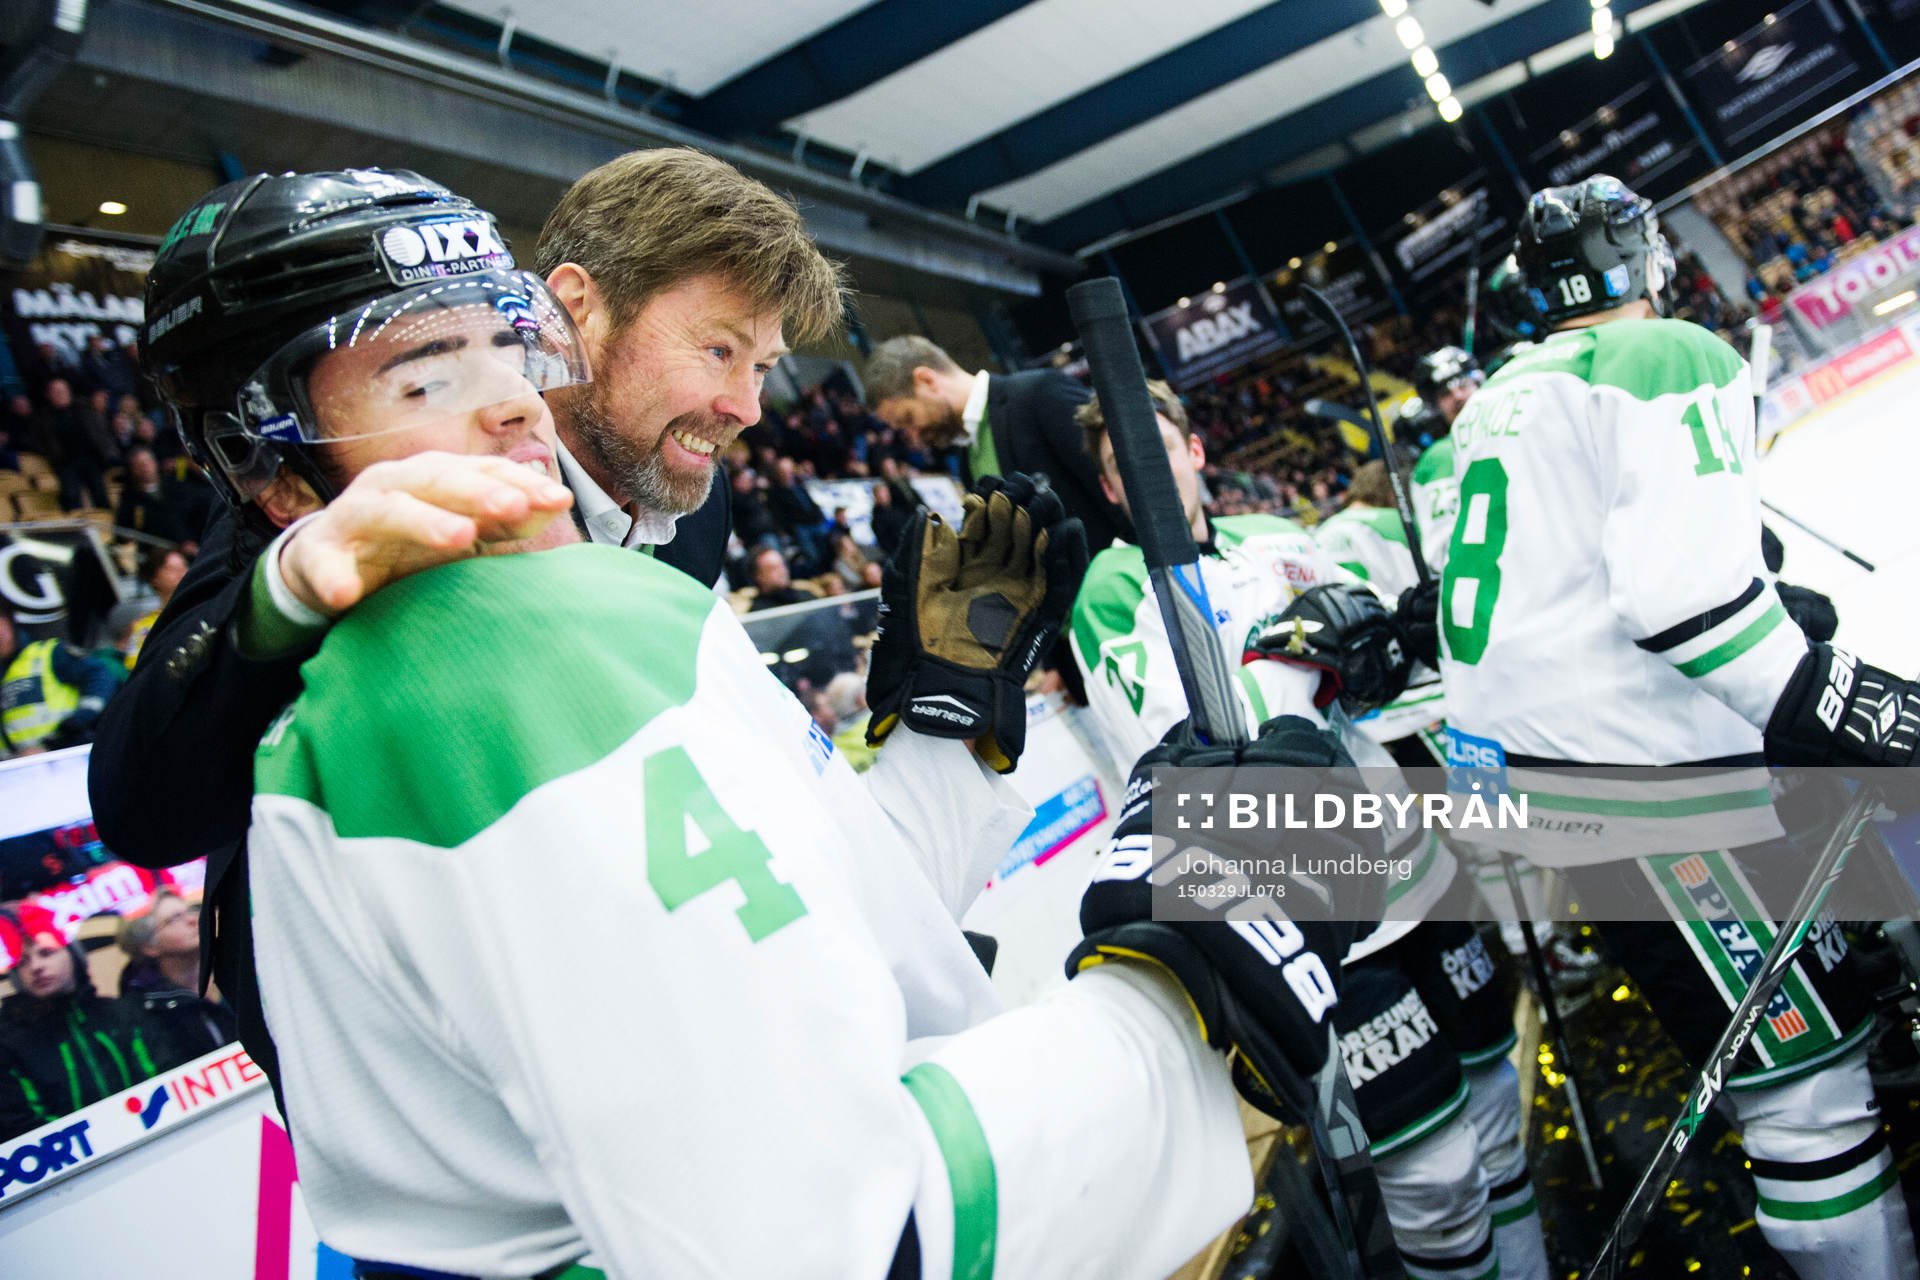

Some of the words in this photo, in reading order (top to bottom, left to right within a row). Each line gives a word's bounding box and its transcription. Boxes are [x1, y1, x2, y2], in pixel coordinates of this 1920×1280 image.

[401, 267, 432, 281] DIN
[1558, 273, 1592, 306] 18
[1176, 300, 1262, 363] ABAX
[643, 744, 809, 944] 4
